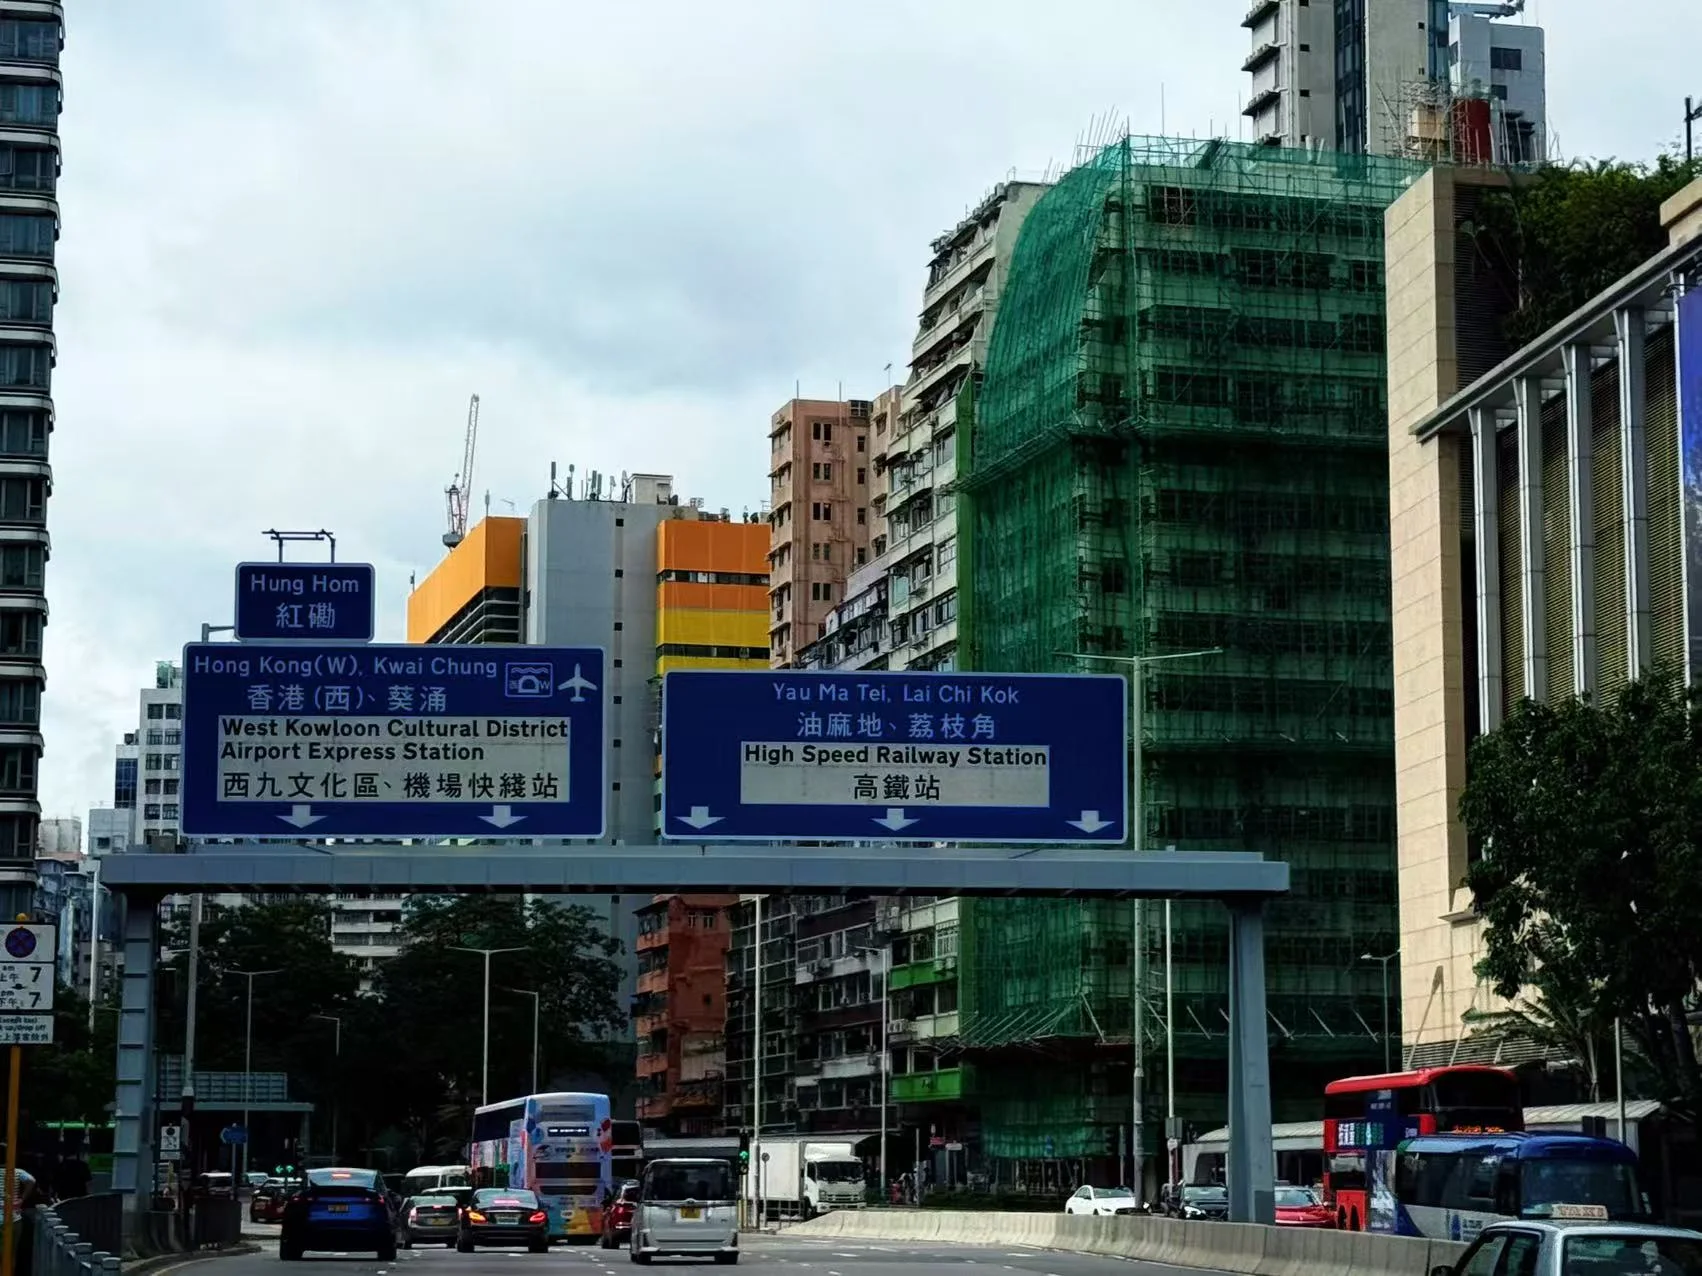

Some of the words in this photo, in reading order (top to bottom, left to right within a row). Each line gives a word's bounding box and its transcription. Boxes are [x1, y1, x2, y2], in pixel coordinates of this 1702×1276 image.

[250, 574, 304, 593] Hung
[313, 575, 359, 593] Hom
[275, 603, 336, 629] 紅磡
[194, 656, 250, 676] Hong
[259, 656, 363, 677] Kong(W),
[374, 657, 423, 675] Kwai
[431, 657, 498, 677] Chung
[773, 683, 811, 701] Yau
[819, 684, 850, 702] Ma
[903, 685, 932, 702] Lai
[940, 685, 972, 703] Chi
[981, 686, 1020, 704] Kok
[222, 719, 278, 737] West
[286, 719, 380, 737] Kowloon
[387, 720, 480, 737] Cultural
[487, 720, 569, 738] District
[797, 711, 997, 739] 油麻地、荔枝角
[221, 742, 300, 761] Airport
[309, 743, 396, 762] Express
[403, 744, 484, 761] Station
[744, 745, 794, 764] High
[802, 746, 869, 766] Speed
[877, 747, 960, 767] Railway
[967, 748, 1047, 766] Station
[223, 772, 559, 800] 西九文化區、機場快綫站
[854, 774, 941, 800] 高鐵站
[30, 966, 42, 982] 7
[29, 992, 41, 1008] 7
